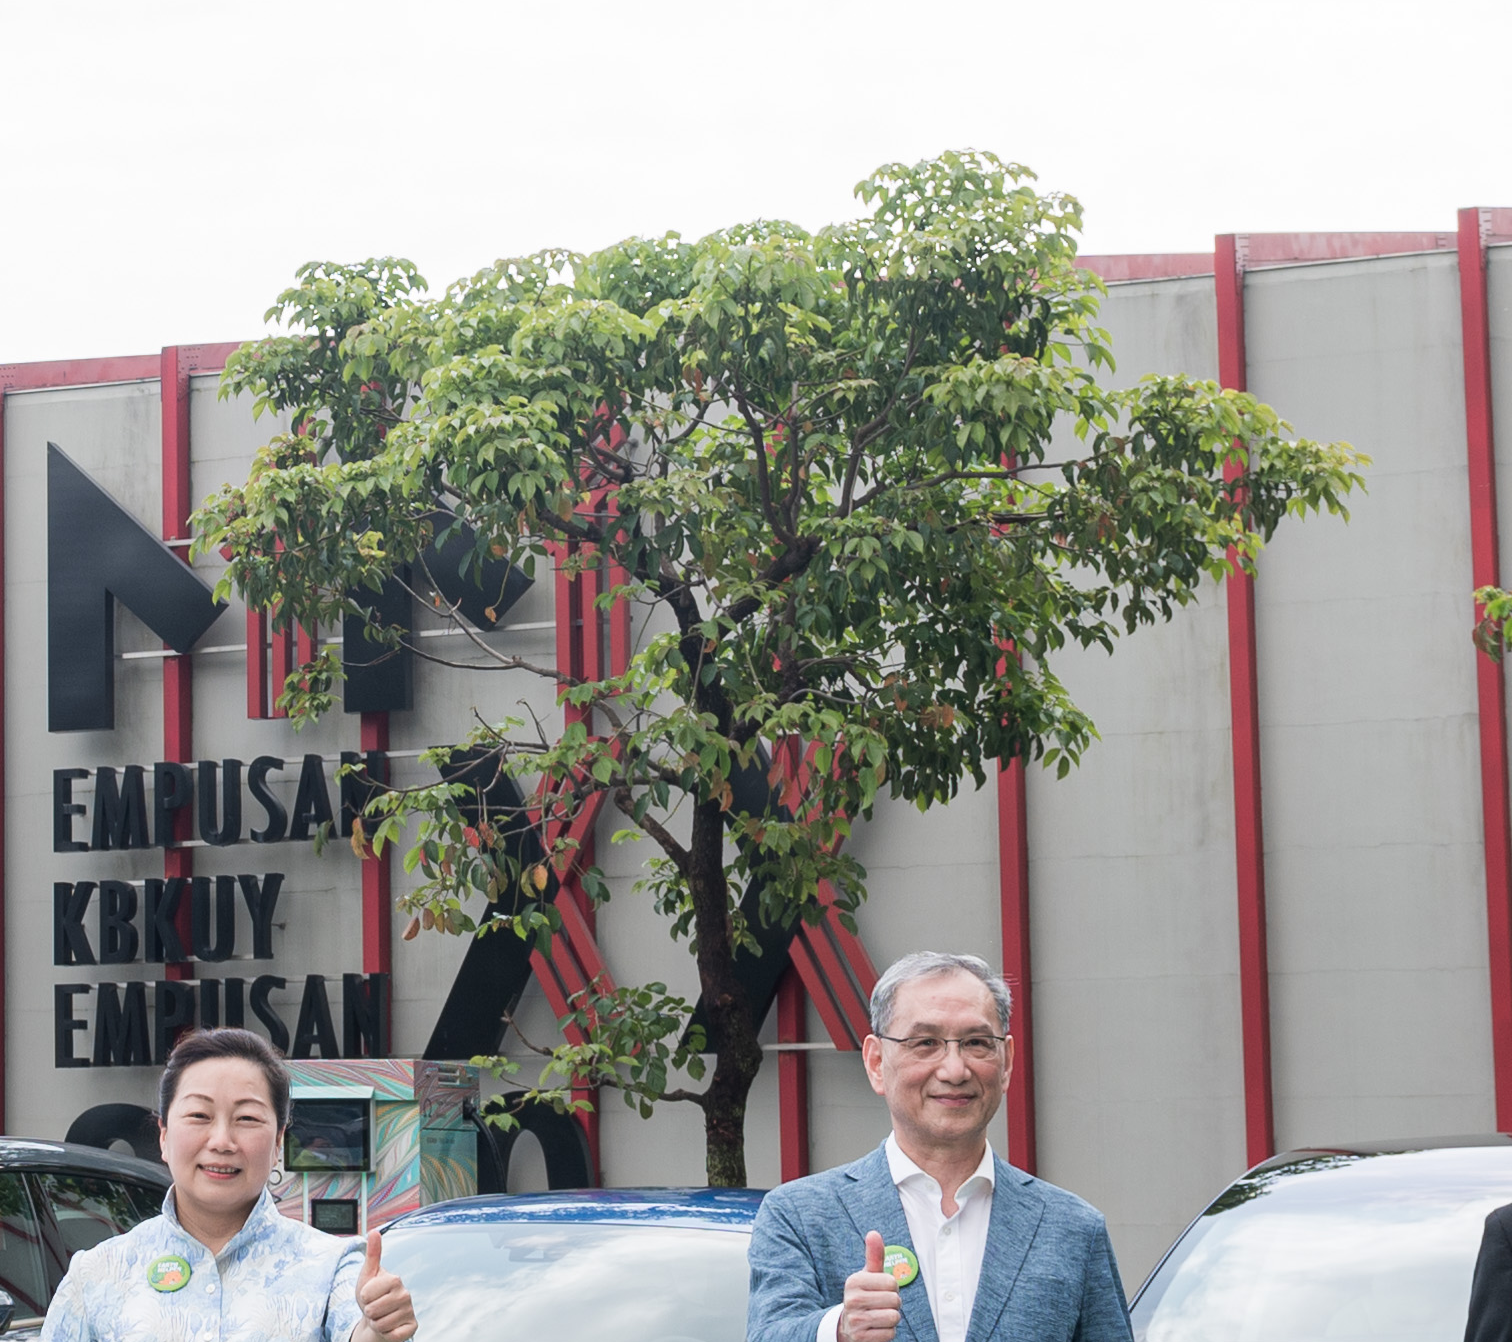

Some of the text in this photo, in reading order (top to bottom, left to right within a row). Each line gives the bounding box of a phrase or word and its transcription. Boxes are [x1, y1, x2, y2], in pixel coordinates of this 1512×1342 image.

[53, 750, 389, 852] EMPUSAN
[53, 872, 285, 966] KBKUY
[54, 972, 391, 1069] EMPUSAN
